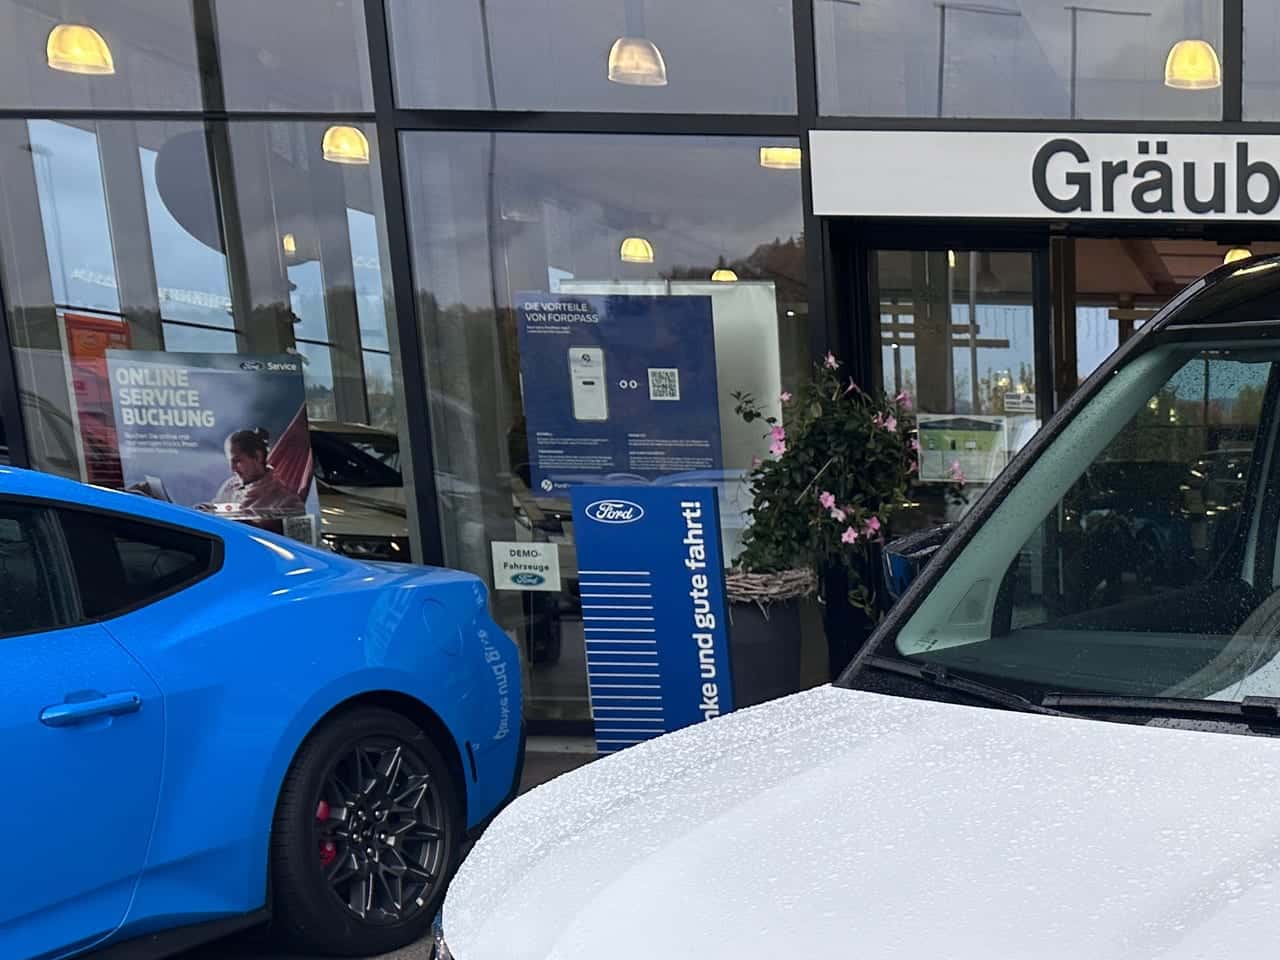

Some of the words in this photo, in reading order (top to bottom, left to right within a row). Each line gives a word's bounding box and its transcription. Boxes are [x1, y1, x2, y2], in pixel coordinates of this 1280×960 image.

[541, 302, 588, 312] VORTEILE
[525, 312, 547, 322] VON
[547, 313, 599, 323] FORDPASS
[267, 362, 297, 371] Service
[115, 367, 190, 387] ONLINE
[119, 388, 200, 408] SERVICE
[122, 407, 216, 427] BUCHUNG
[596, 502, 634, 521] Ford
[681, 501, 707, 570] fahrt!
[509, 549, 542, 558] DEMO-
[503, 561, 550, 573] Fahrzeuge
[690, 573, 716, 630] gute
[692, 633, 716, 679] und
[698, 681, 720, 722] nke
